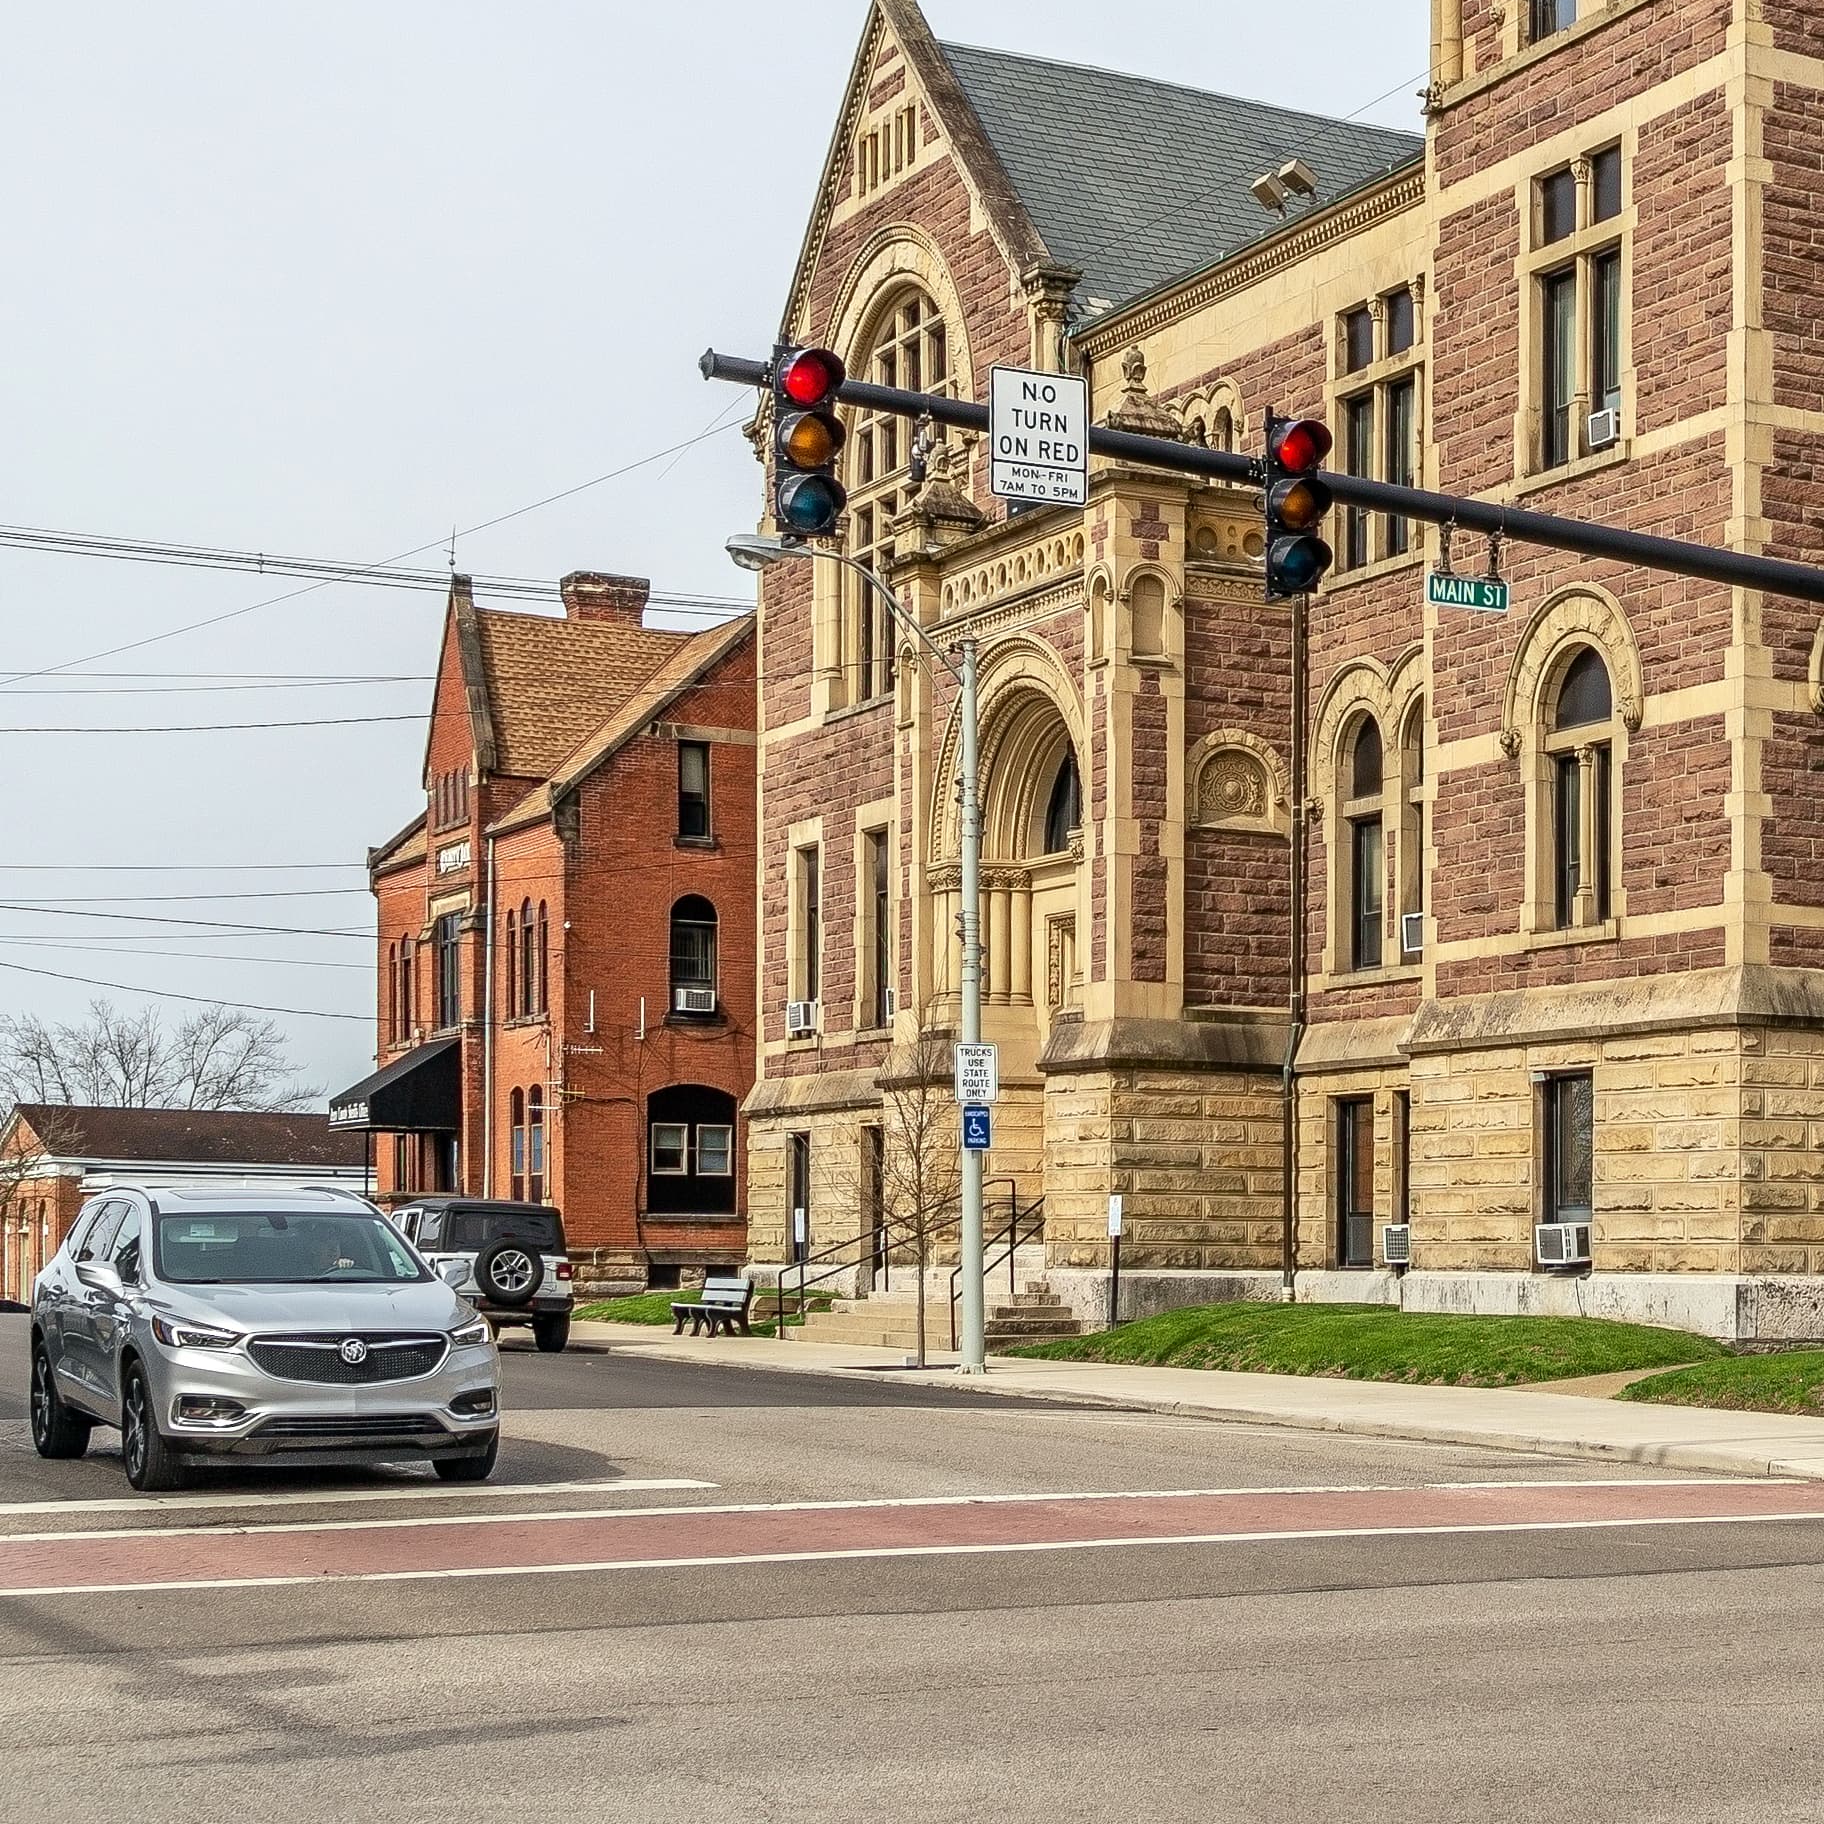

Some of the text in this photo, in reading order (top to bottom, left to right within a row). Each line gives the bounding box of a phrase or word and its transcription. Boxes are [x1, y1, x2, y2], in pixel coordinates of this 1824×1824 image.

[1023, 381, 1056, 403] NO
[1011, 408, 1067, 433] TURN
[1000, 435, 1078, 463] ON RED
[1000, 480, 1078, 498] 7AM TO 5PM
[1433, 578, 1503, 607] MAIN ST
[960, 1048, 992, 1056] TRUCKS
[968, 1059, 984, 1067] USE
[963, 1069, 989, 1077] STATE
[962, 1079, 990, 1087] ROUTE
[966, 1089, 986, 1097] ONLY
